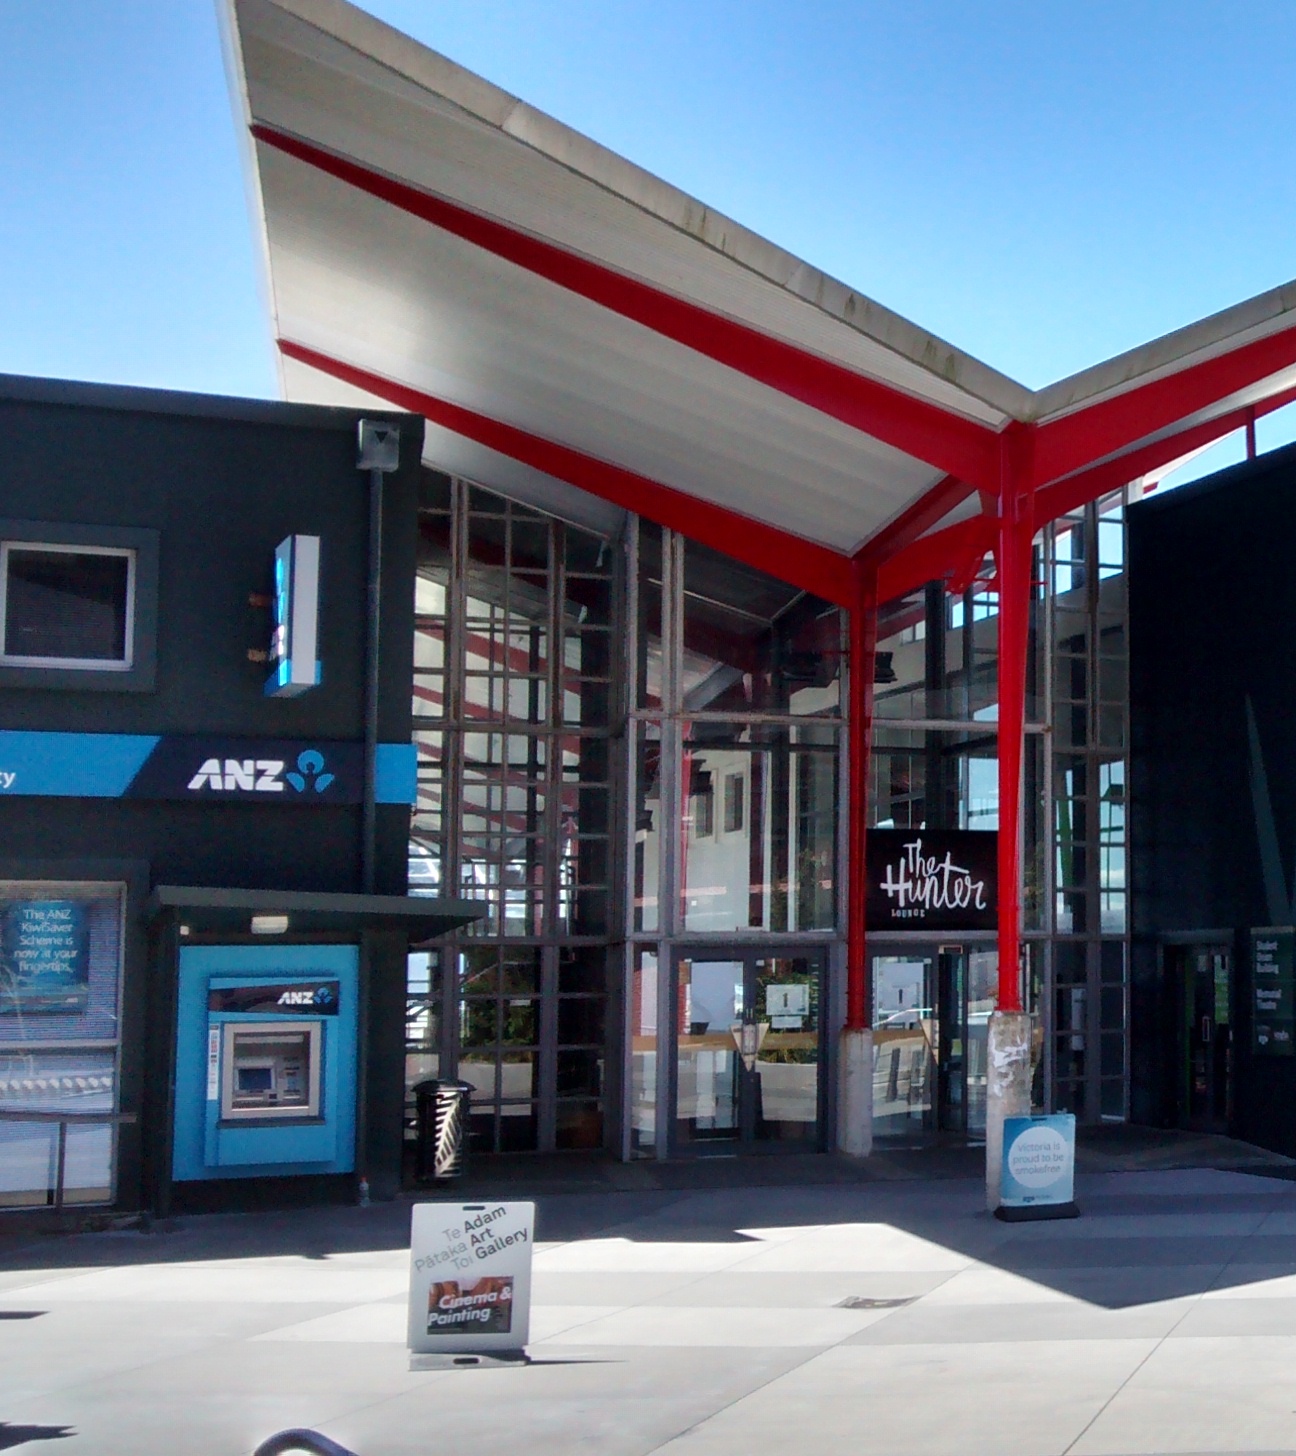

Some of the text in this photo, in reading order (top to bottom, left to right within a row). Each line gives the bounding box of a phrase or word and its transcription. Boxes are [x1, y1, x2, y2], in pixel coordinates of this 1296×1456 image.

[187, 758, 284, 791] ANZ
[903, 838, 941, 878] The
[880, 851, 987, 910] Hunter
[23, 909, 71, 920] The ANZ
[891, 909, 925, 918] LOUNGE
[21, 922, 73, 932] KiwiSaver
[277, 991, 314, 1005] ANZ
[1018, 1142, 1060, 1152] Victoria is
[1013, 1153, 1065, 1165] proud to be
[1015, 1164, 1061, 1175] smokefree
[442, 1206, 506, 1242] Te Adam
[470, 1228, 494, 1247] Art
[450, 1227, 528, 1271] Toi Gallery
[438, 1286, 512, 1309] Cinema &
[428, 1308, 490, 1326] Painting
